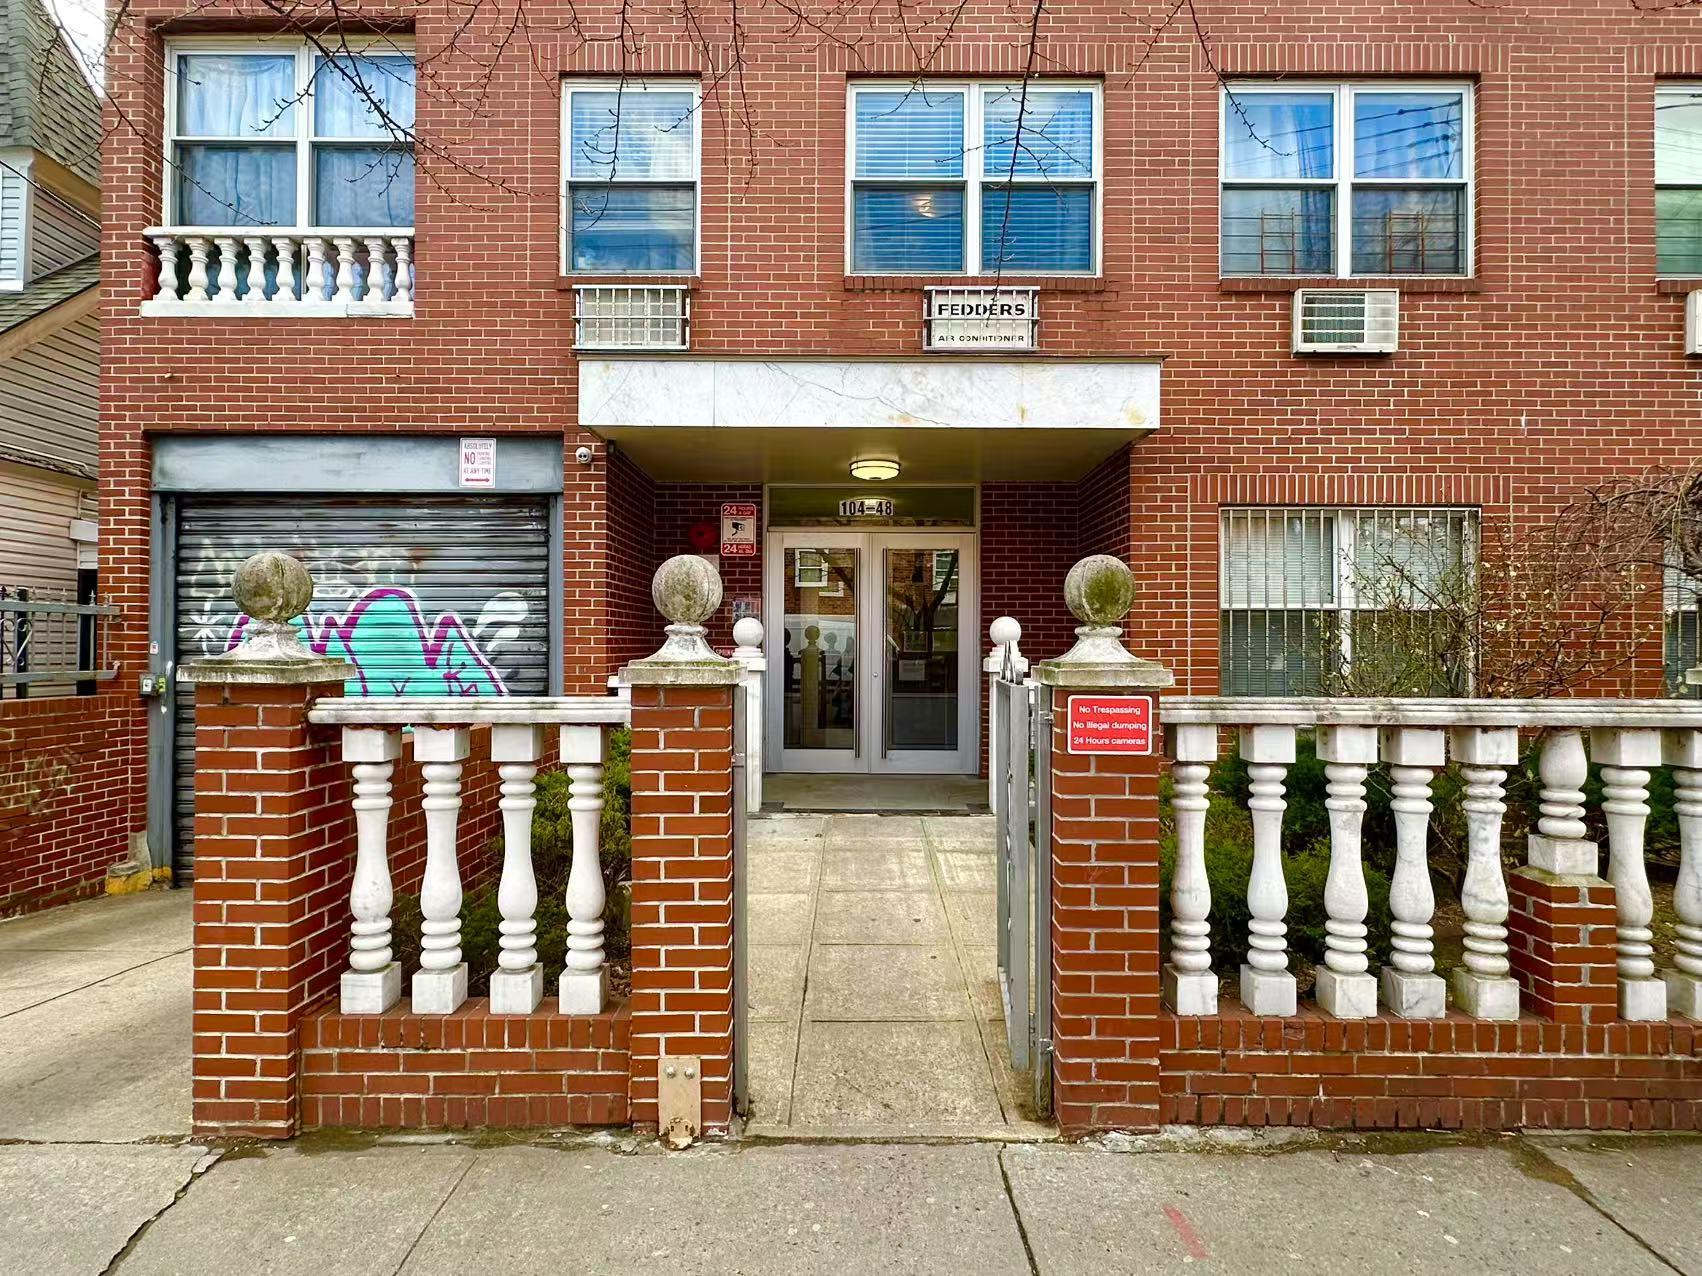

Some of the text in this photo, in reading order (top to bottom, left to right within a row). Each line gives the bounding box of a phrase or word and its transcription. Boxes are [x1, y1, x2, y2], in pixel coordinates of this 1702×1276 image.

[938, 303, 1025, 316] FEDDERS
[464, 451, 476, 465] NO
[723, 505, 737, 515] 24
[841, 501, 892, 515] 104-48
[723, 544, 737, 553] 24
[1079, 706, 1140, 715] No Trespassing
[1073, 721, 1147, 730] No Illegal dumping
[1073, 736, 1084, 744] 24
[1085, 737, 1110, 745] Hours
